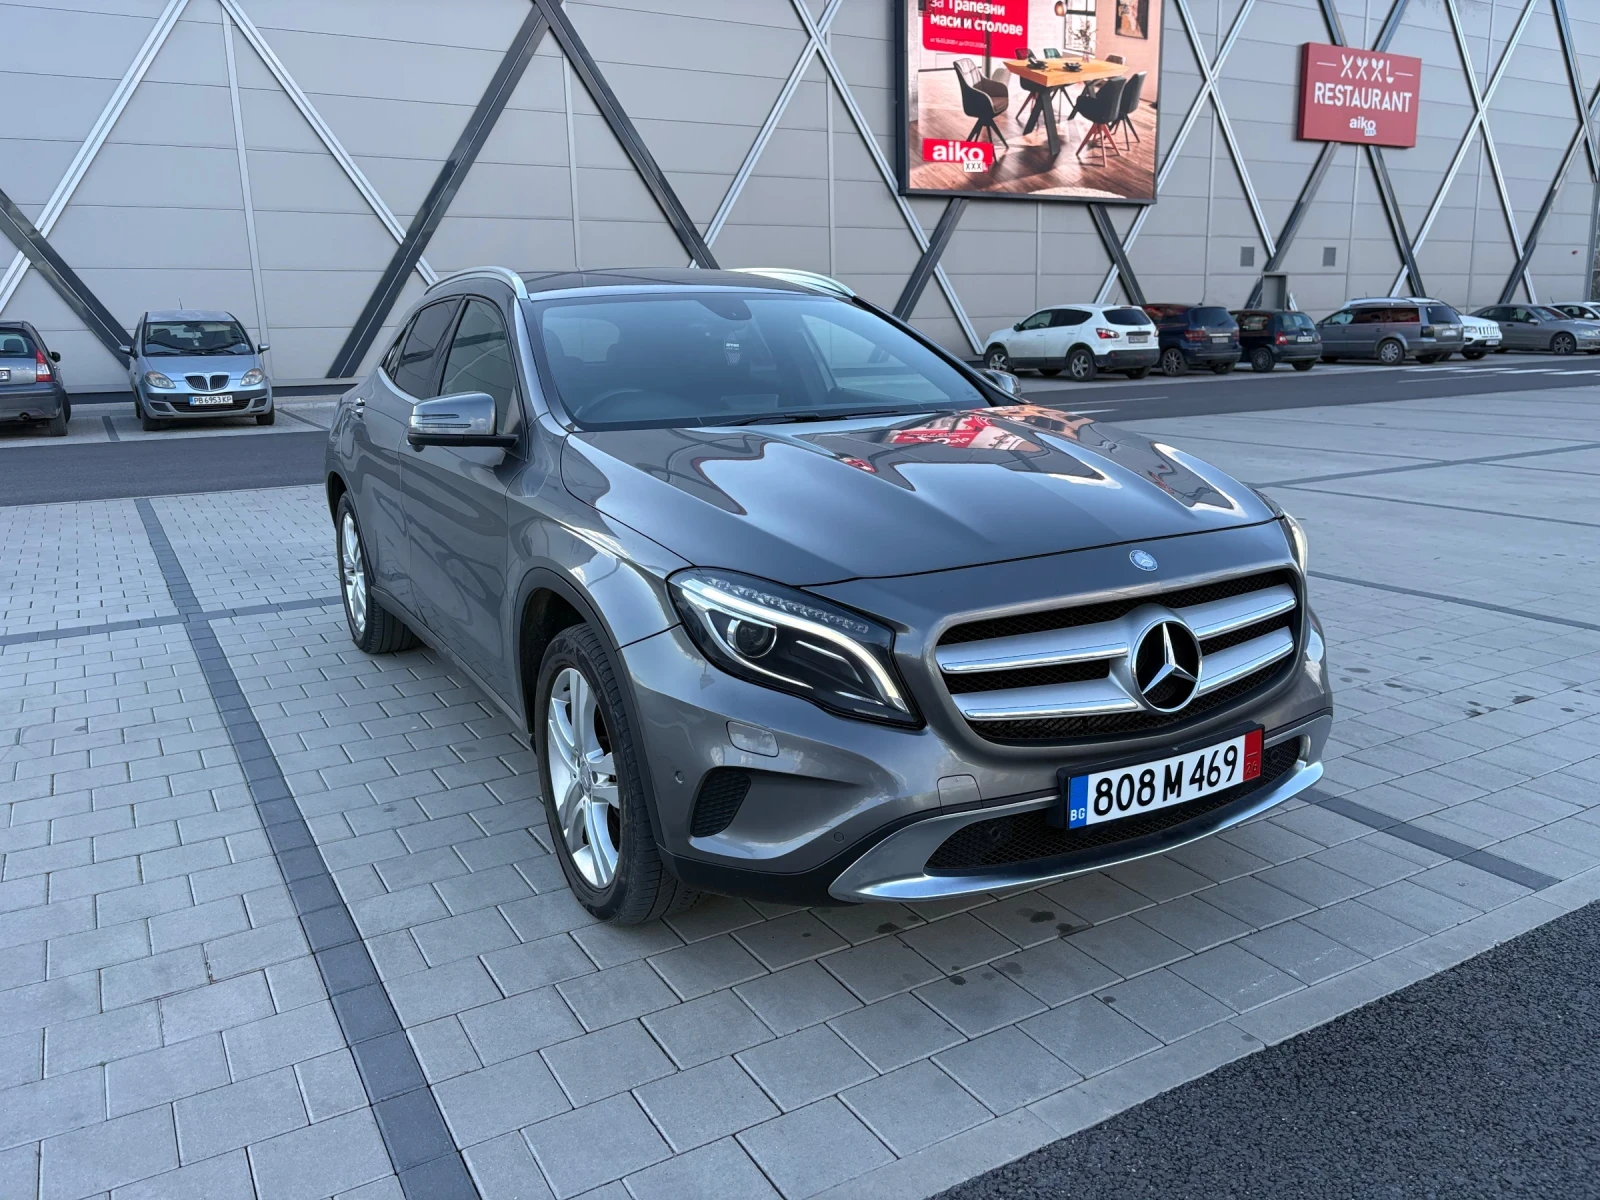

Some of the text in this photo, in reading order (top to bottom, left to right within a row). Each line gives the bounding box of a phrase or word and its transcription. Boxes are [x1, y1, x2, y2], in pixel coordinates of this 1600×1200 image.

[930, 14, 1023, 36] маси и столове
[1314, 81, 1412, 113] RESTAURANT
[1349, 116, 1376, 129] aiko
[932, 141, 984, 162] aiko
[204, 396, 221, 404] 6953
[222, 395, 232, 403] KP
[1093, 745, 1238, 816] 808 M 469
[1070, 808, 1086, 821] BG
